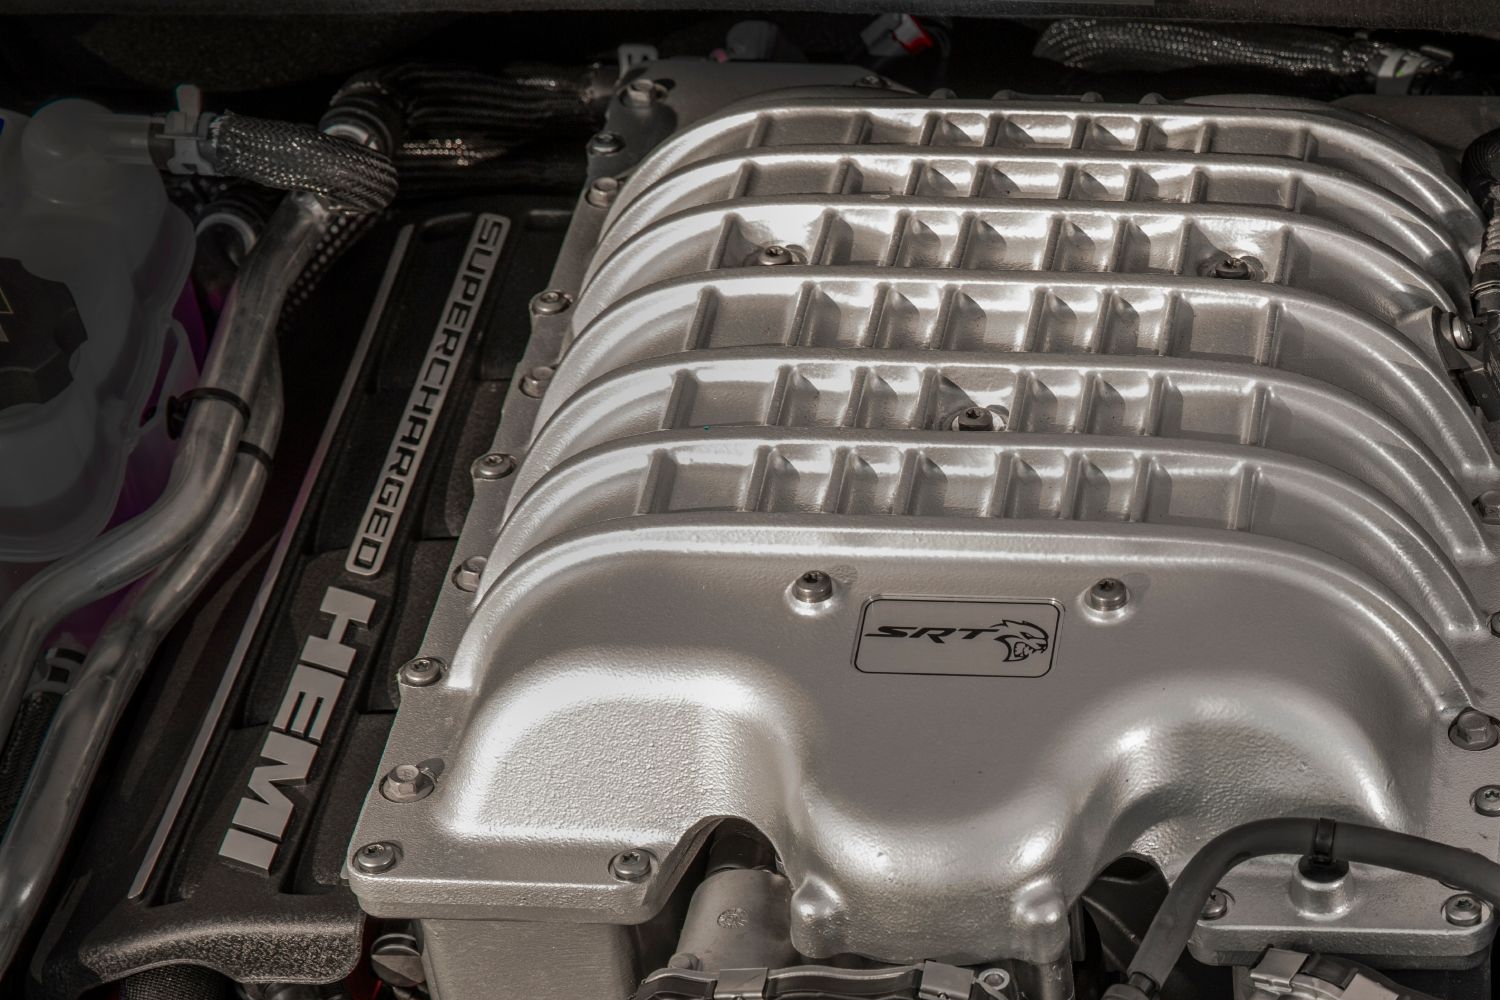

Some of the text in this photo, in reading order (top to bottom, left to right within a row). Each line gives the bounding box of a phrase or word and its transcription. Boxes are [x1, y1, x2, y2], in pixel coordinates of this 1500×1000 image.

[352, 216, 503, 571] SUPERCHARGED
[218, 586, 376, 872] HEMI
[864, 625, 1000, 644] SRT
